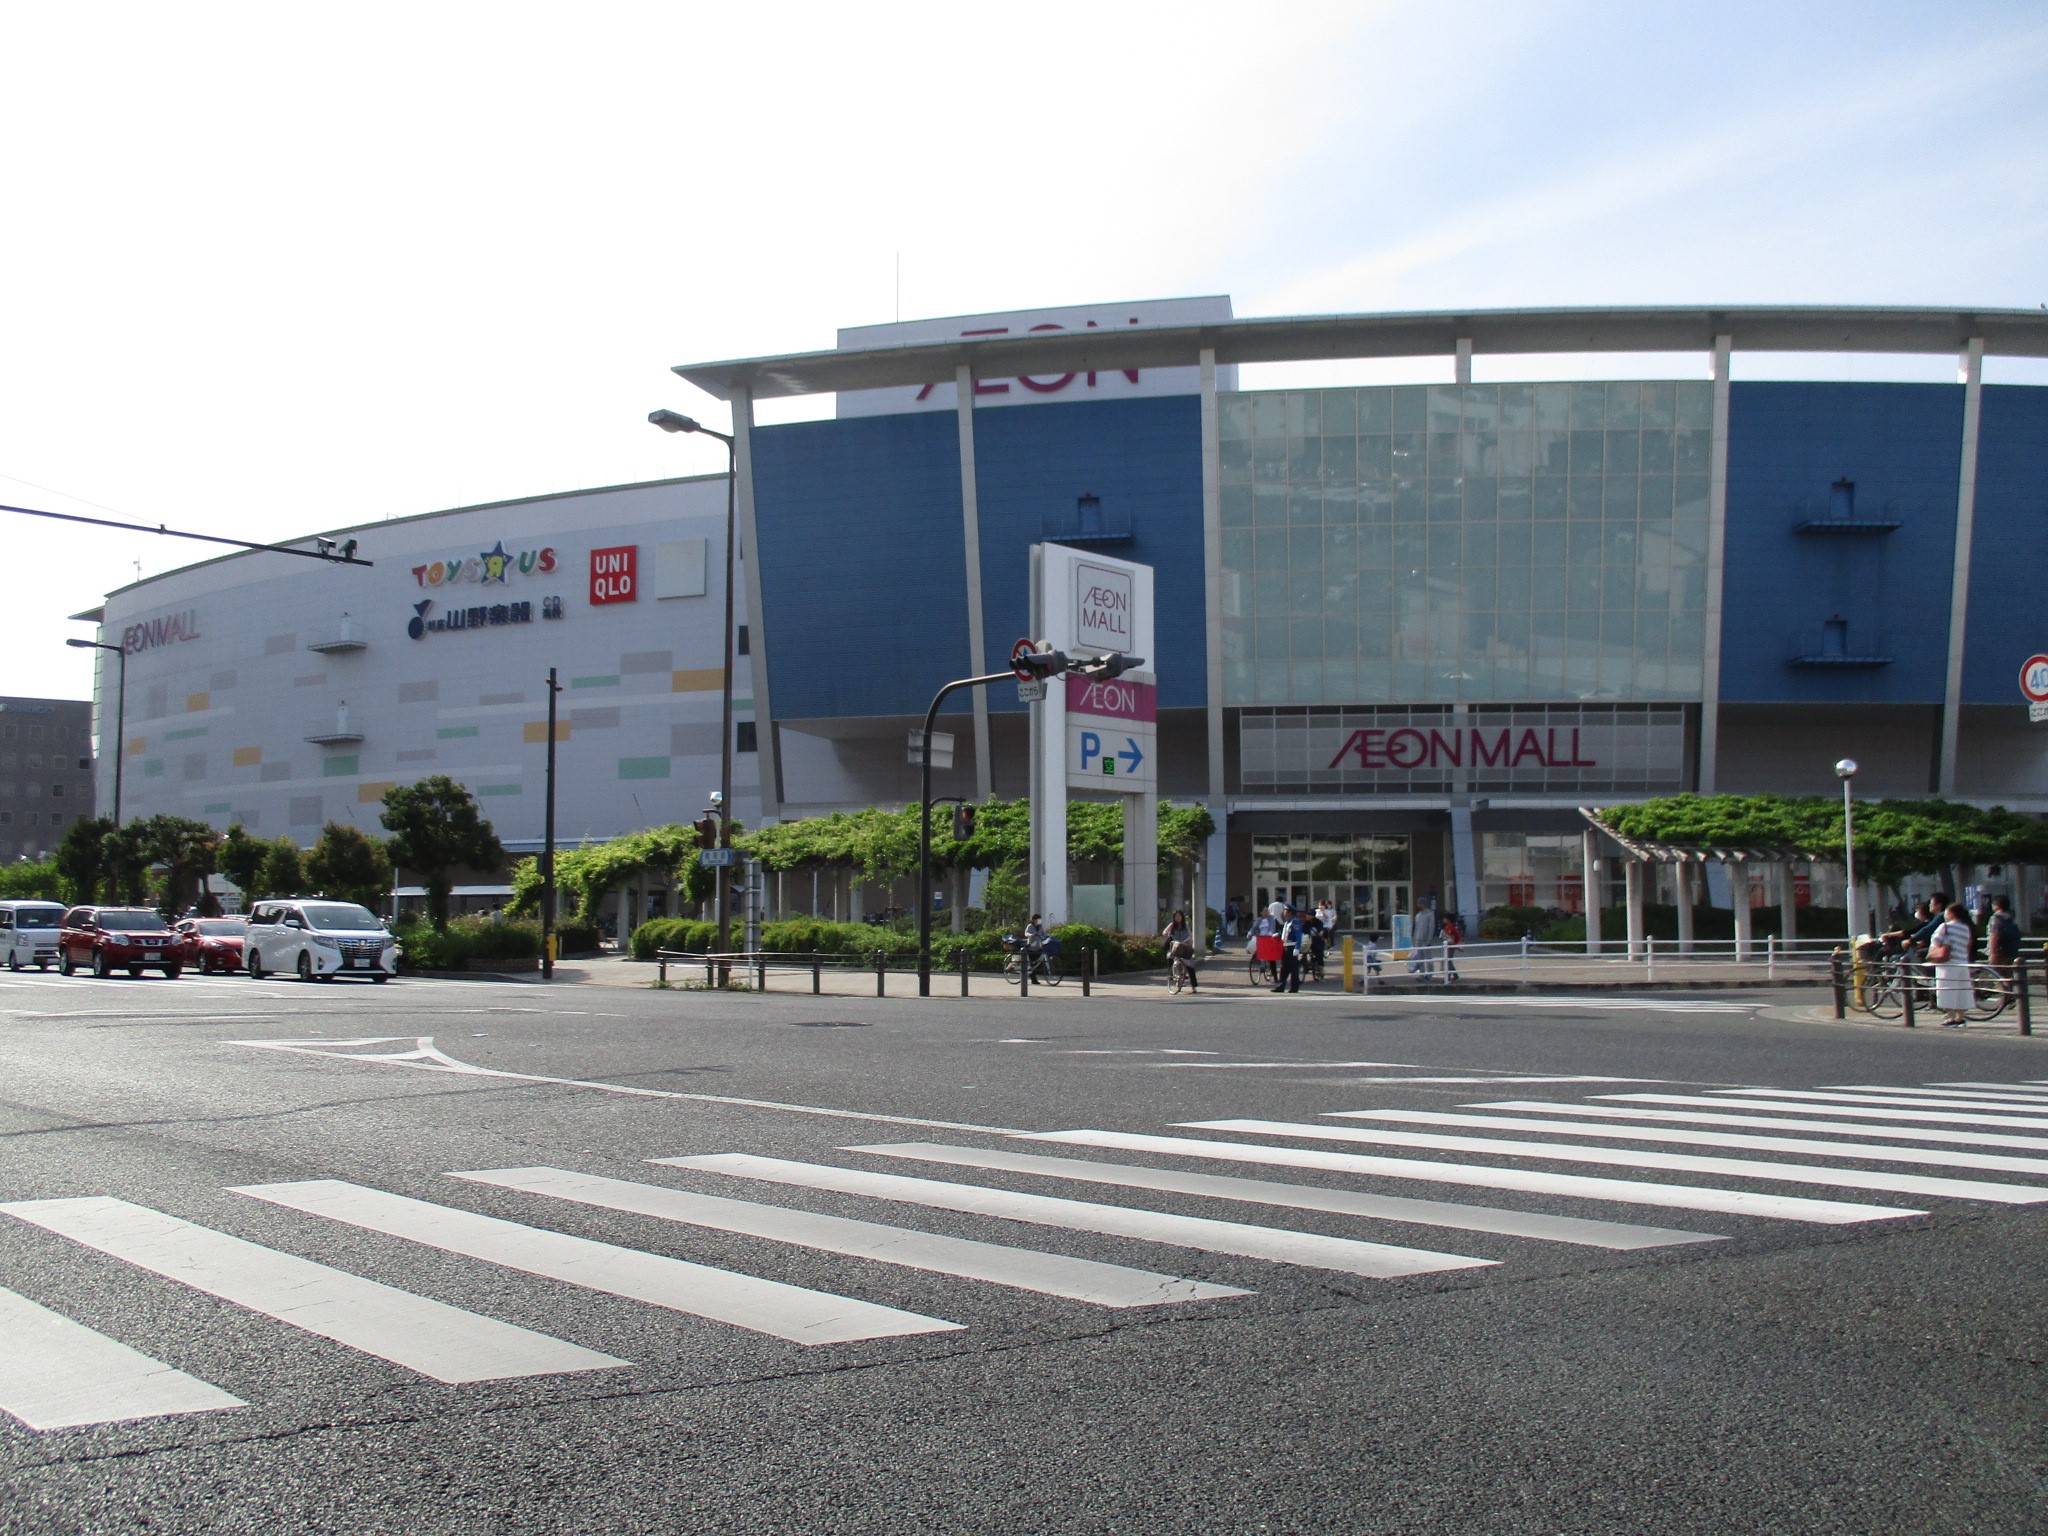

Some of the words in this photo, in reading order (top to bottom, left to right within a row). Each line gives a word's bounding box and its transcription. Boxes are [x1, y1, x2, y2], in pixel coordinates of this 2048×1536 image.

[412, 556, 480, 587] TOYS
[518, 547, 556, 574] US
[595, 552, 628, 574] UNI
[595, 575, 631, 600] QLO
[1083, 607, 1126, 634] MALL
[1080, 731, 1100, 770] P
[1471, 728, 1596, 767] MALL
